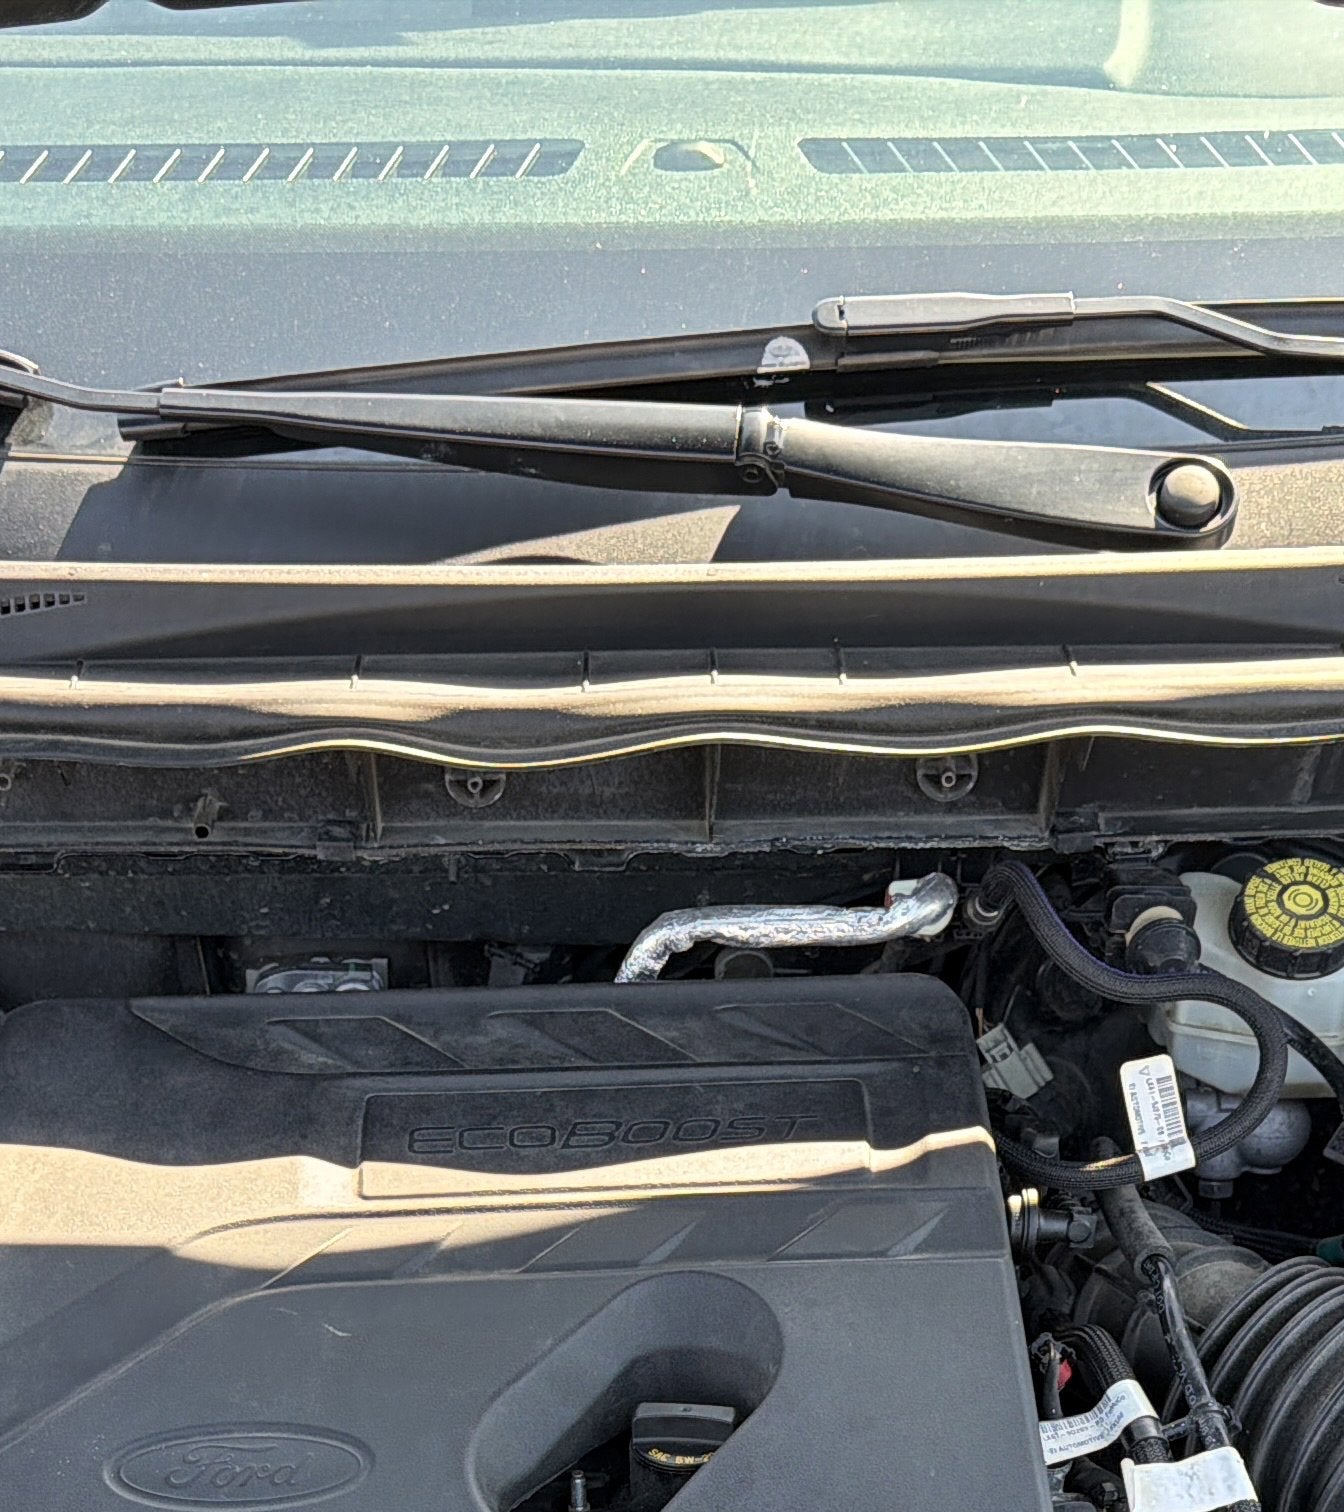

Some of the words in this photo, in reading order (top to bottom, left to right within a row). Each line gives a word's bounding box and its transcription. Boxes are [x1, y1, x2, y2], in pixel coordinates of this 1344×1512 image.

[407, 1114, 819, 1155] ECOBOOST
[166, 1443, 297, 1488] Ford
[648, 1448, 671, 1462] SAE
